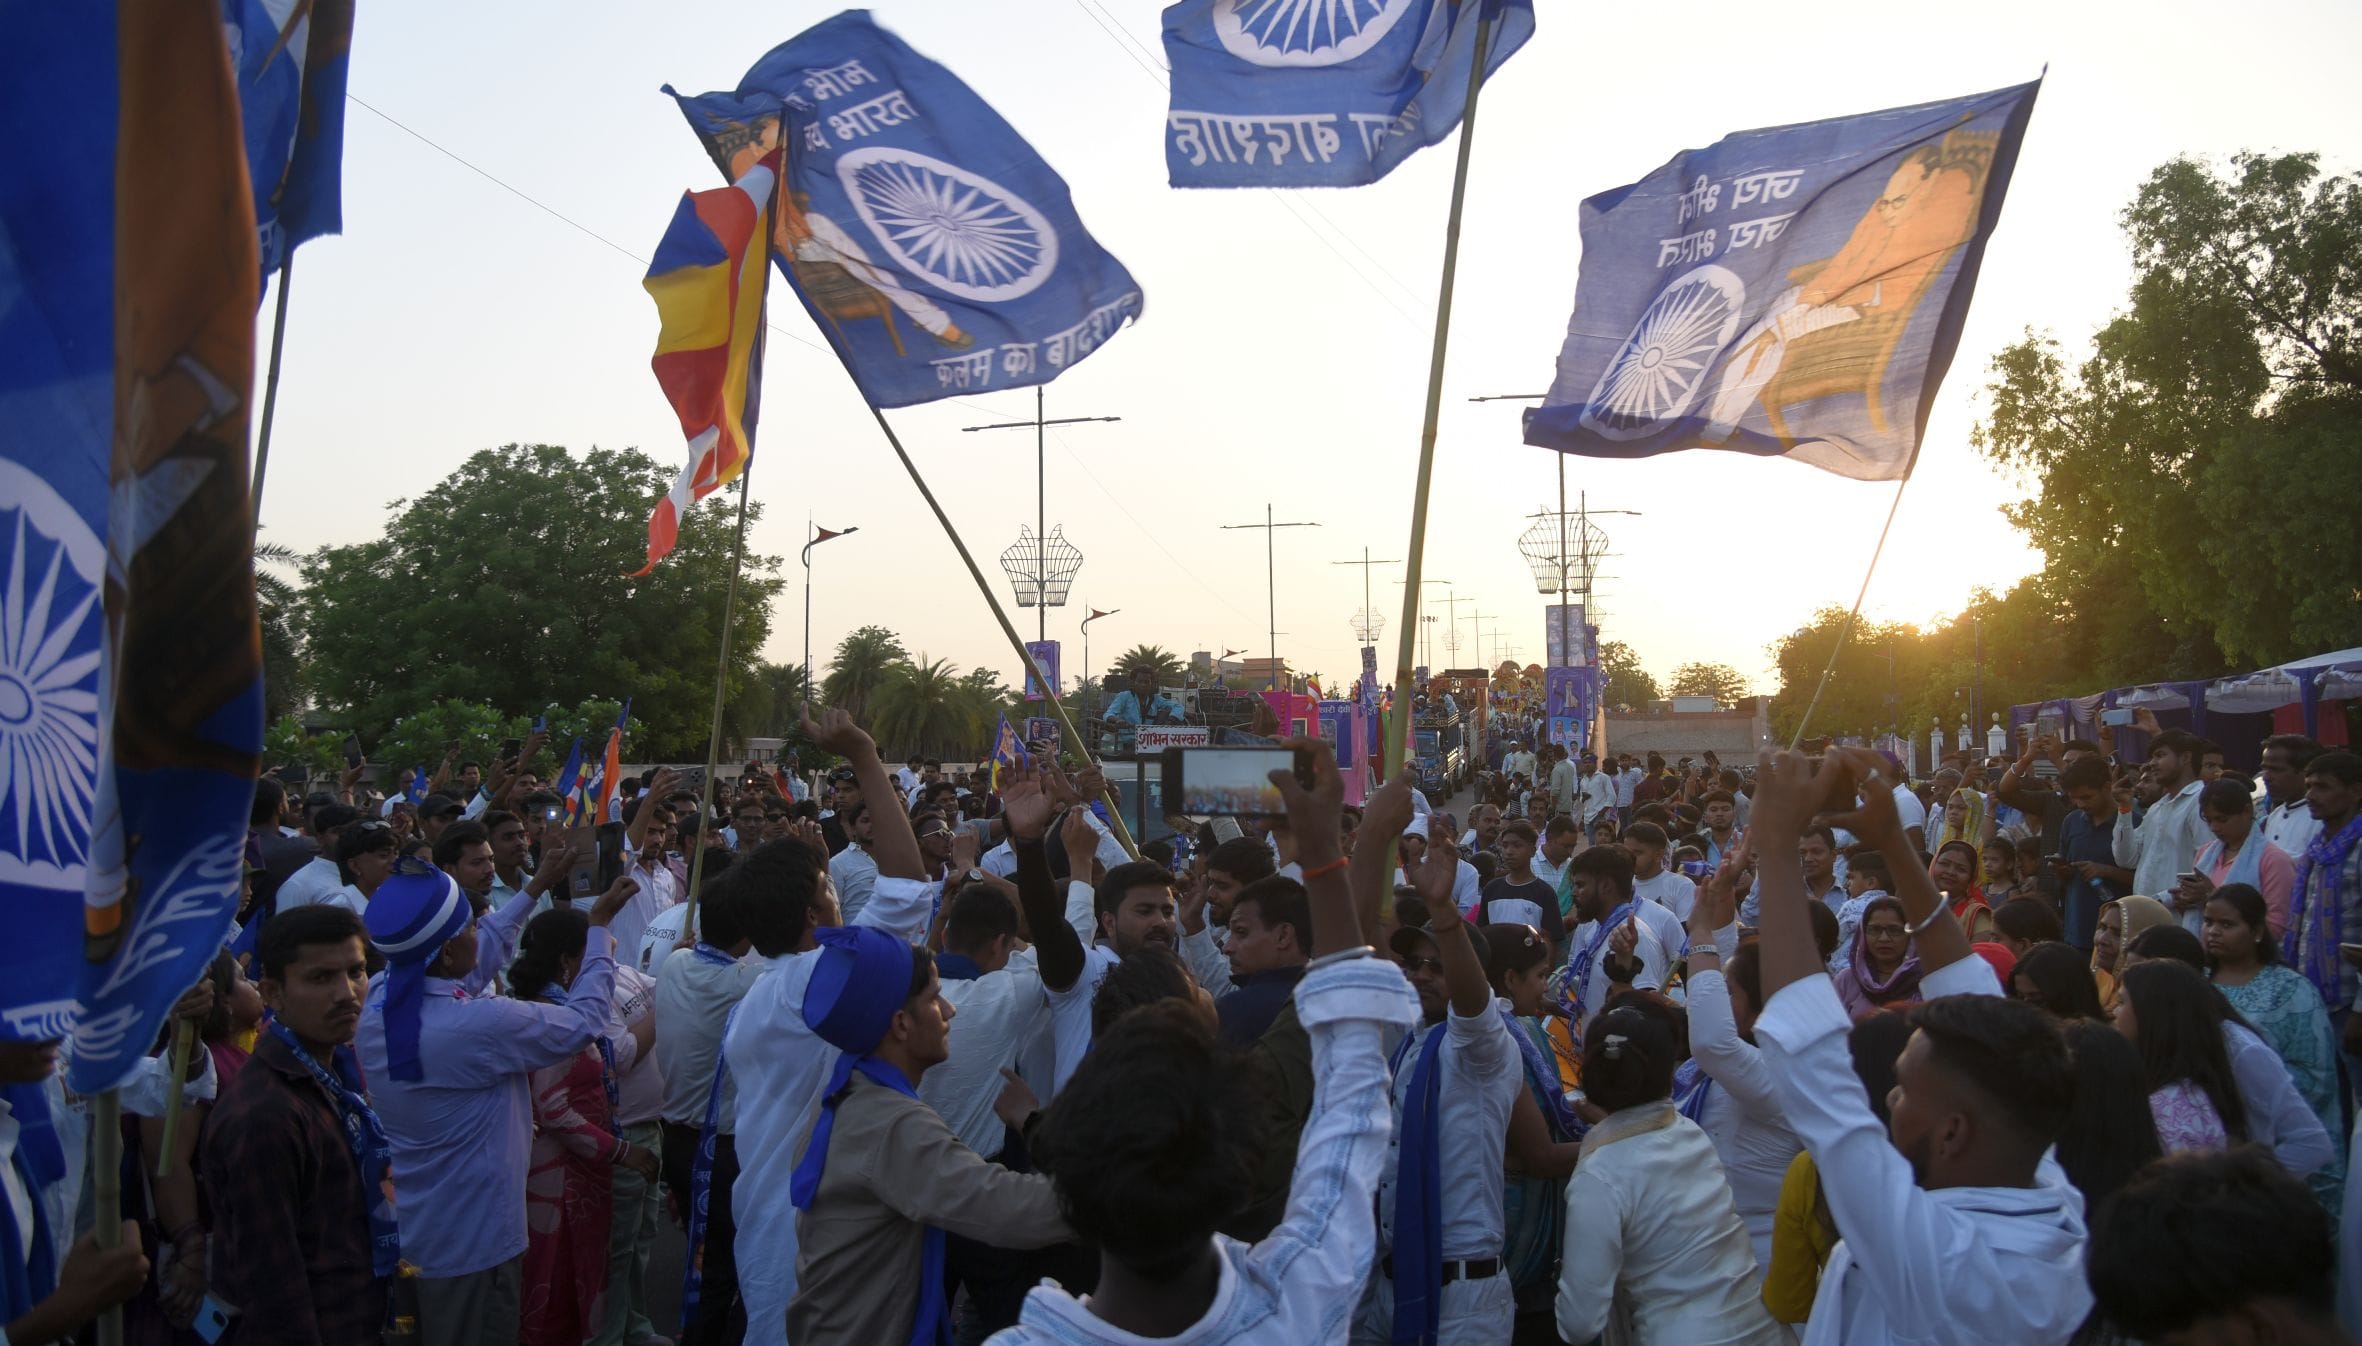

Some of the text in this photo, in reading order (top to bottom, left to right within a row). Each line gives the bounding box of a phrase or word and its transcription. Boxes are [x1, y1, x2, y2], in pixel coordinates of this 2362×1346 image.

[829, 90, 919, 142] भारत
[929, 347, 995, 389] कलम
[1001, 342, 1038, 378] का
[1170, 733, 1207, 746] सरकार
